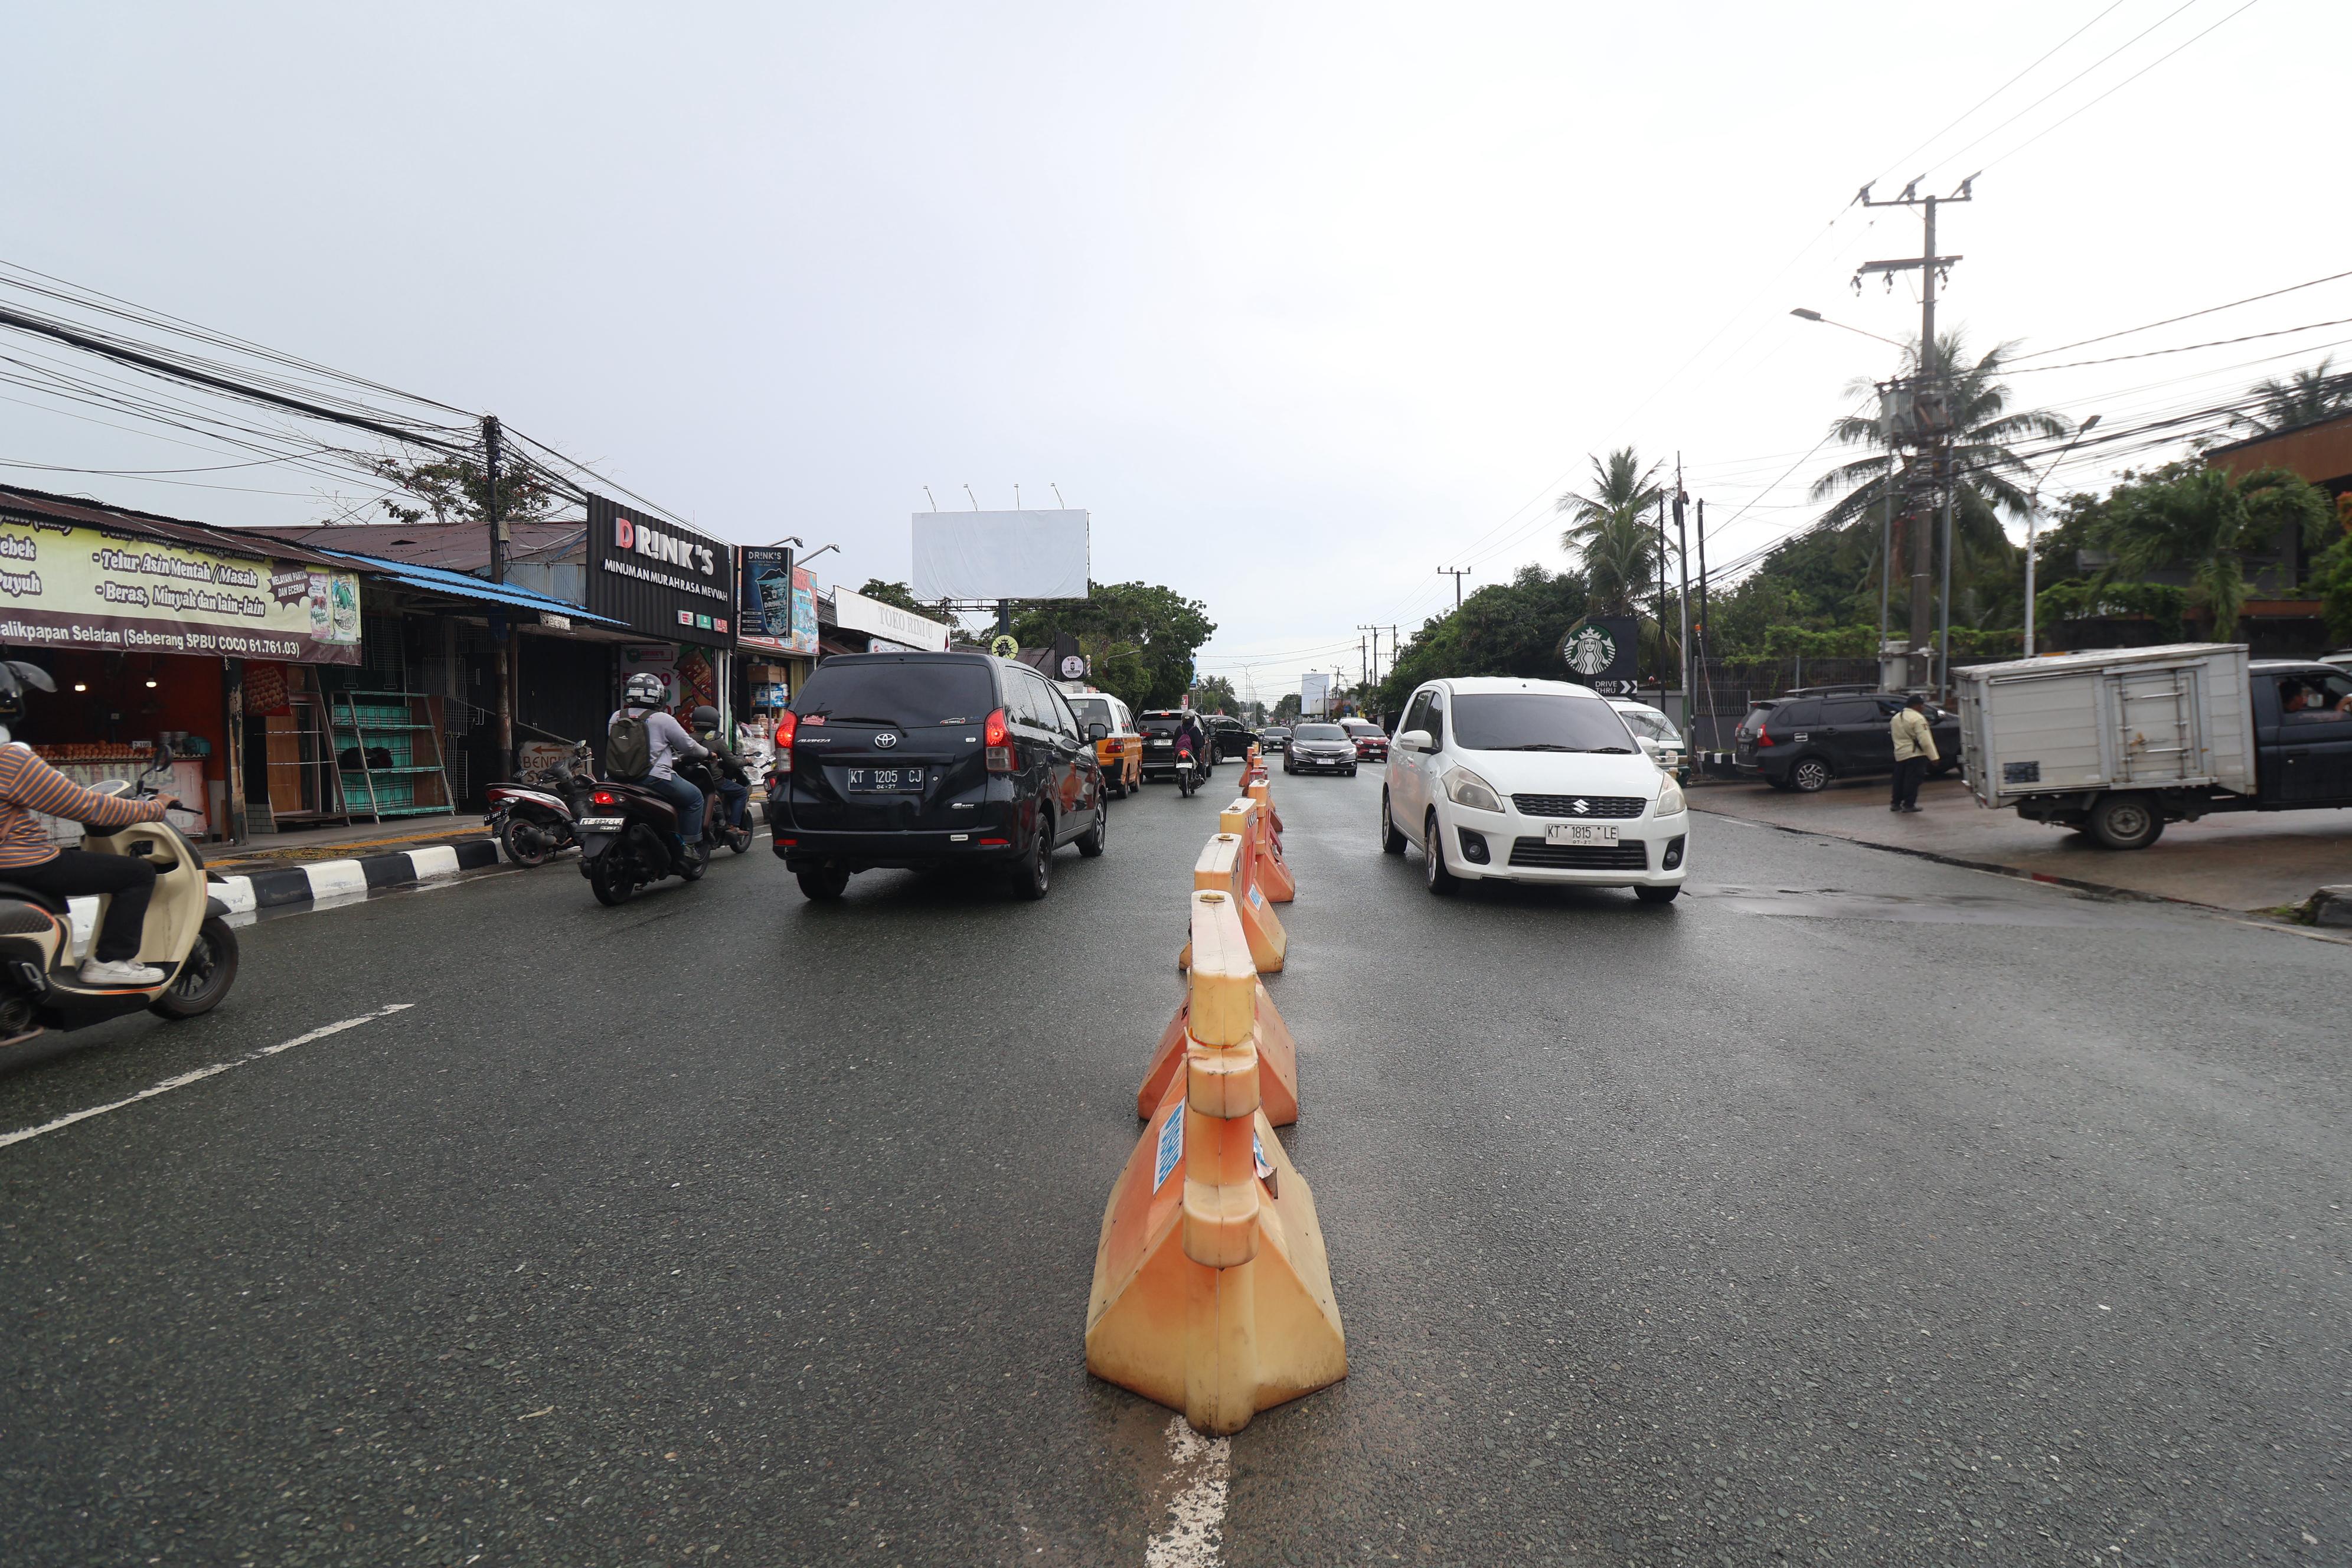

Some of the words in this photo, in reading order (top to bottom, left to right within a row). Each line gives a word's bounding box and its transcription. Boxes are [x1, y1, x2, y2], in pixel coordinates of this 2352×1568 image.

[0, 537, 35, 560] ebek
[102, 550, 141, 571] Telur
[141, 553, 171, 574] Asin
[171, 560, 211, 582] Mentah
[219, 566, 258, 587] Masak
[271, 573, 292, 586] MELAYANI
[293, 570, 308, 581] PARTAI
[605, 558, 649, 582] MINUMAN
[650, 571, 680, 589] MURAH
[680, 579, 700, 594] RASA
[105, 582, 148, 607] Beras,
[153, 586, 197, 610] Minyak
[198, 592, 217, 610] dan
[217, 593, 265, 616] lain-lain
[278, 587, 288, 597] DAN
[288, 583, 305, 596] ECERAN
[878, 606, 905, 631] TOKO
[0, 620, 69, 642] alikpapan
[72, 625, 120, 643] Selatan
[124, 628, 183, 651] (Seberang
[187, 633, 215, 649] SPBU
[219, 638, 247, 651] COCO
[250, 639, 299, 658] 61.761.03)
[850, 770, 864, 783] KT
[874, 770, 897, 783] 1205
[909, 770, 921, 782] CJ
[1548, 825, 1560, 838] KT
[1572, 826, 1591, 838] 1815
[1604, 827, 1616, 839] LE
